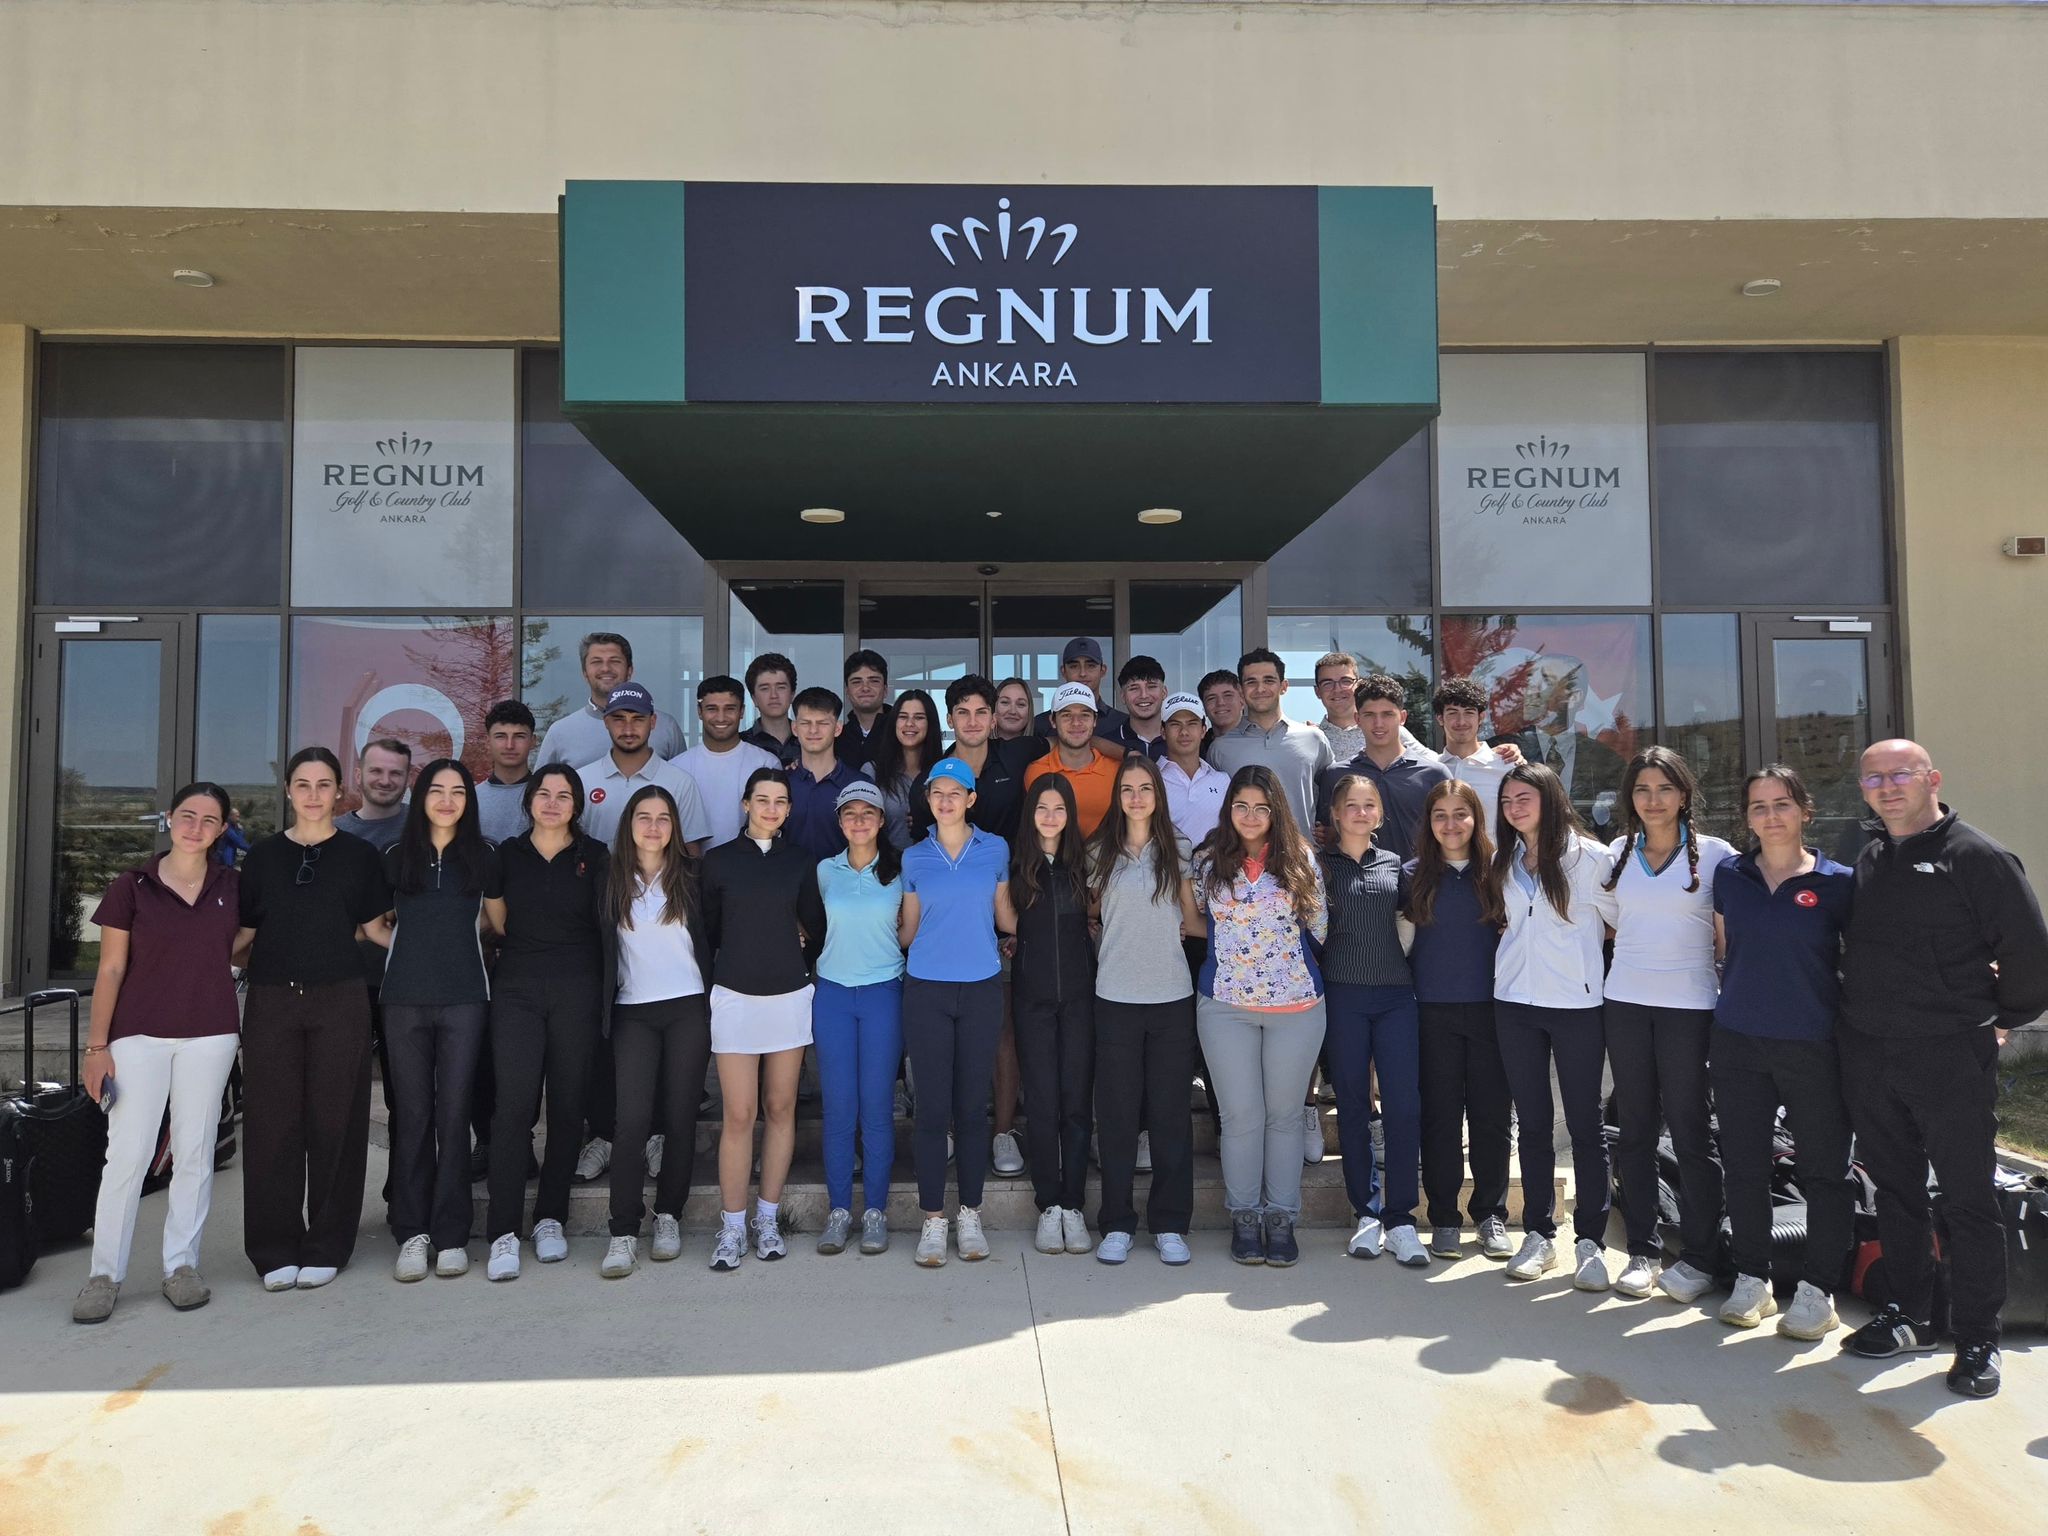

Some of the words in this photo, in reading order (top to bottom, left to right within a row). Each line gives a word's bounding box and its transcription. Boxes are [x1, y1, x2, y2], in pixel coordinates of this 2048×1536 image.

[795, 286, 1213, 345] REGNUM
[931, 361, 1078, 388] ANKARA
[323, 464, 484, 487] REGNUM
[1466, 467, 1621, 489] REGNUM
[329, 490, 369, 514] Golf
[369, 491, 383, 507] &
[385, 490, 437, 513] Country
[440, 490, 472, 507] Club
[1474, 492, 1511, 516] Golf
[1511, 493, 1524, 509] &
[1526, 492, 1576, 515] Country
[1579, 492, 1610, 509] Club
[380, 514, 427, 523] ANKARA
[1522, 516, 1567, 525] ANKARA
[609, 689, 643, 703] SRIXON
[1058, 687, 1092, 701] Titleist
[1165, 695, 1200, 709] Titleist
[841, 788, 877, 798] TaylorMade
